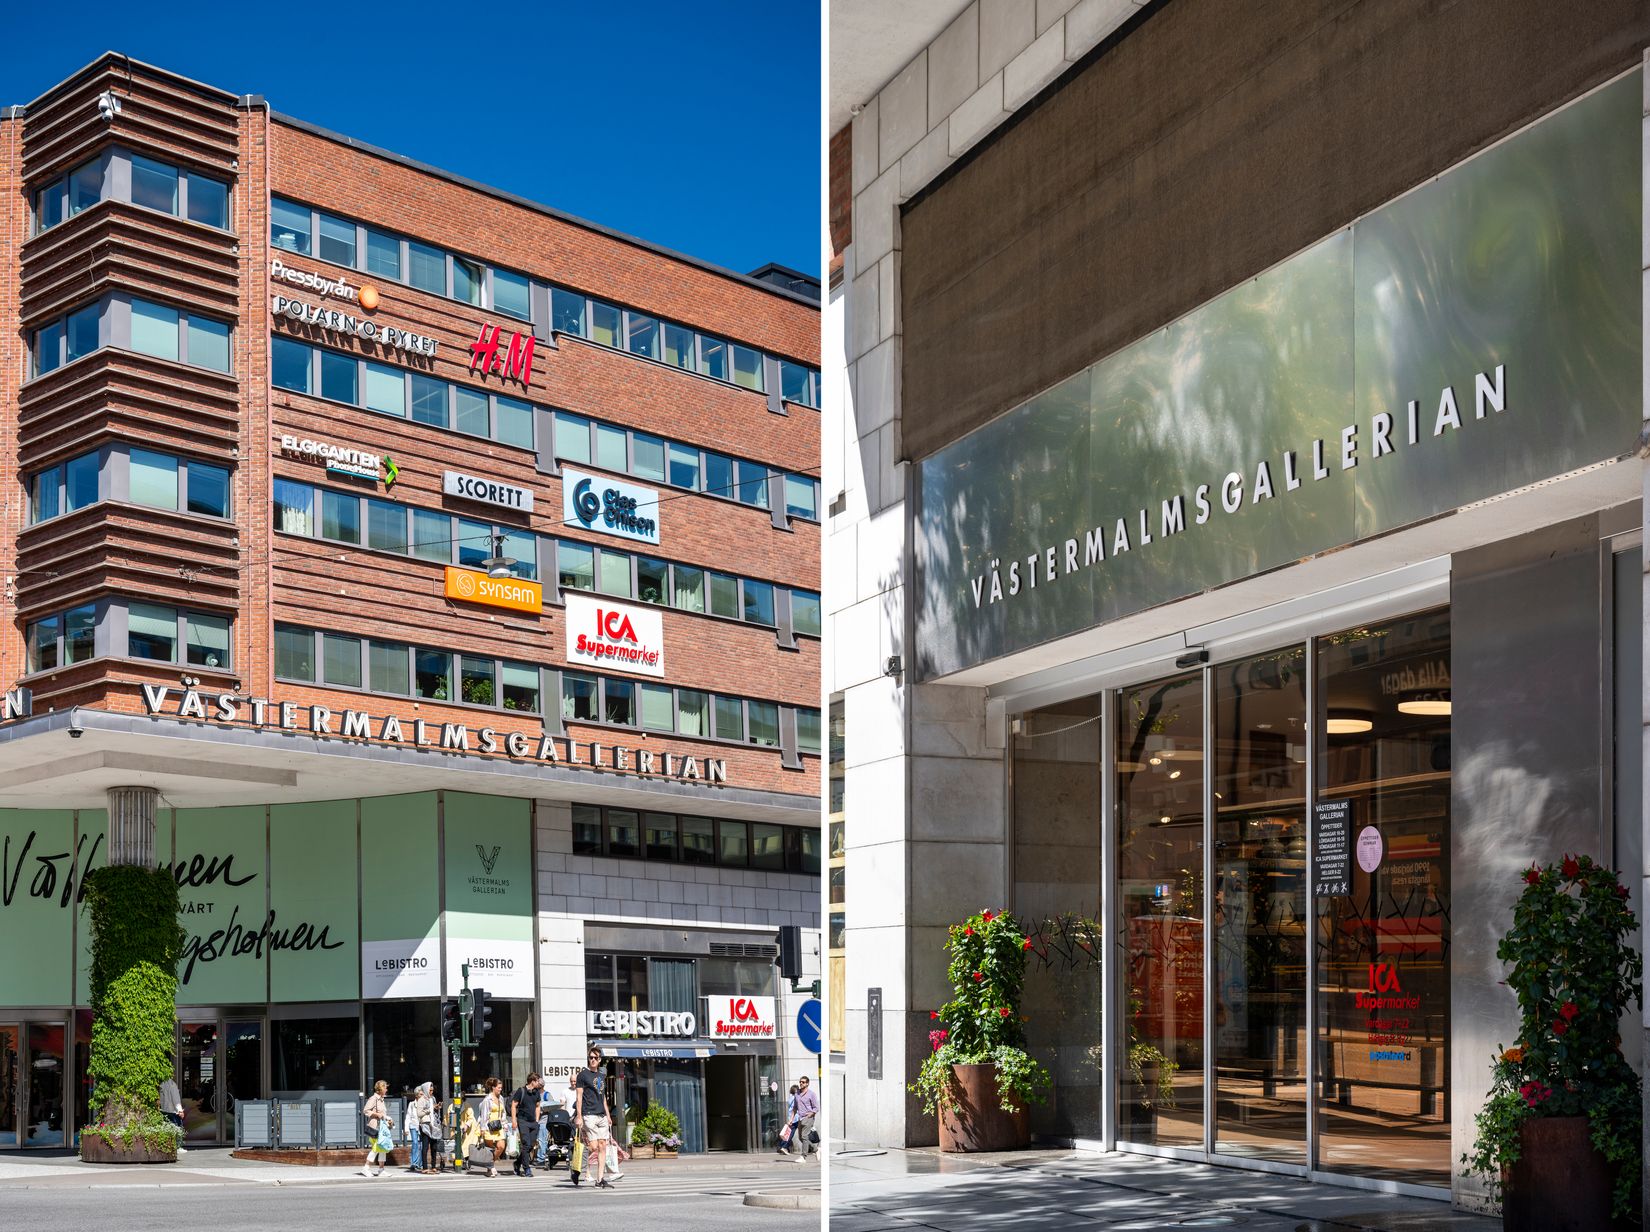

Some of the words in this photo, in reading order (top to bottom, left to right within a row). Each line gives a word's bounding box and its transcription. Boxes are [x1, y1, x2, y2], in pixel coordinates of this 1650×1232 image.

[271, 259, 354, 299] Pressbyrån
[273, 295, 356, 336] POLARN
[382, 326, 439, 357] PYRET
[470, 322, 536, 386] H&M
[281, 434, 380, 469] ELGIGANTEN
[457, 476, 523, 507] SCORETT
[970, 363, 1507, 609] VÄSTERMALMSGALLERIAN
[602, 488, 638, 511] Clas
[603, 506, 656, 533] Ohlson
[479, 581, 535, 605] SYNSAM
[596, 608, 639, 643] ICA
[576, 633, 660, 664] Supermarket
[141, 677, 727, 784] VÄSTERMALMSGALLERIAN
[1320, 811, 1345, 820] GALLERIAN
[467, 875, 510, 886] VÄSTERMALMS
[472, 886, 506, 895] GALLERIAN
[179, 901, 215, 914] VÅRT
[375, 957, 428, 970] LeBISTRO
[467, 957, 514, 970] LeBISTRO
[1369, 963, 1401, 993] ICA
[729, 998, 759, 1021] ICA
[1355, 992, 1421, 1012] Supermarket
[586, 1010, 696, 1036] LeBISTRO
[716, 1020, 774, 1037] Supermarket
[642, 1049, 673, 1057] LeBISTRO
